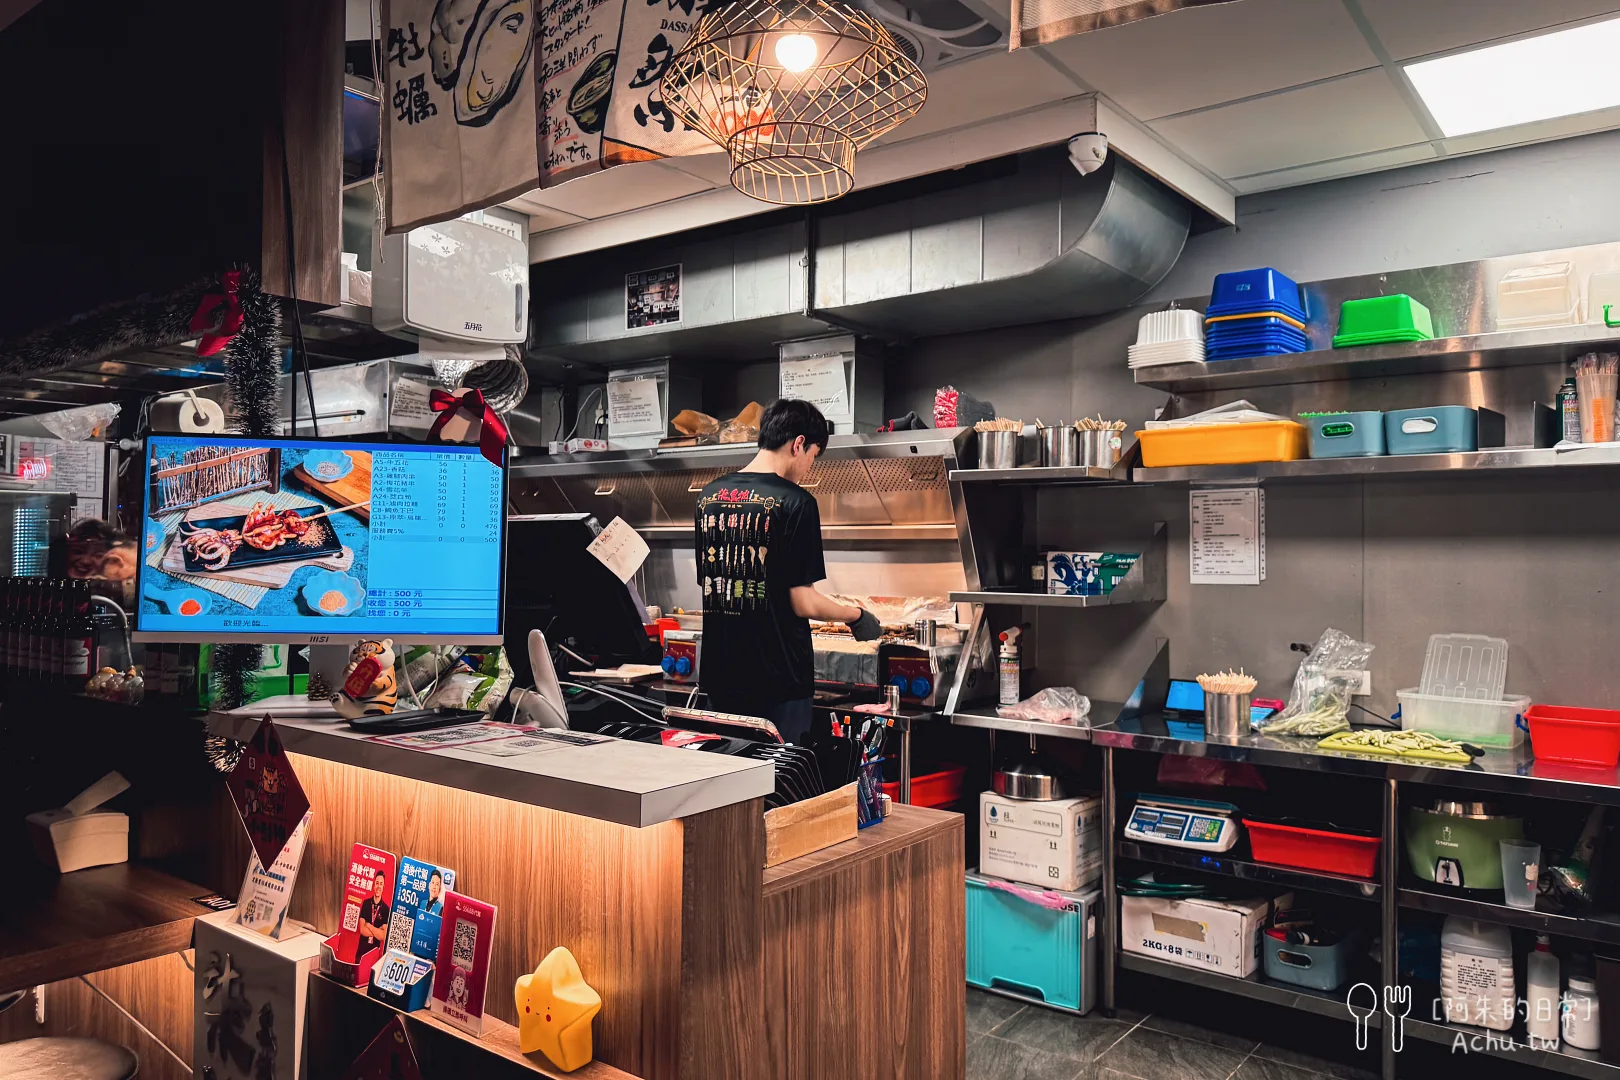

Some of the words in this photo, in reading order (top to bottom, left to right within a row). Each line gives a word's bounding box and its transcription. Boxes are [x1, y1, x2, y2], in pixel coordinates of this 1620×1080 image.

[660, 18, 700, 35] DASSA
[386, 20, 438, 126] 牡蠣
[464, 321, 483, 332] 五月花
[350, 862, 376, 880] 酒後代駕
[402, 862, 429, 881] 酒後代駕
[348, 874, 374, 892] 安全無價
[400, 874, 427, 893] 第一品牌
[401, 889, 416, 905] 350
[383, 962, 409, 984] $600
